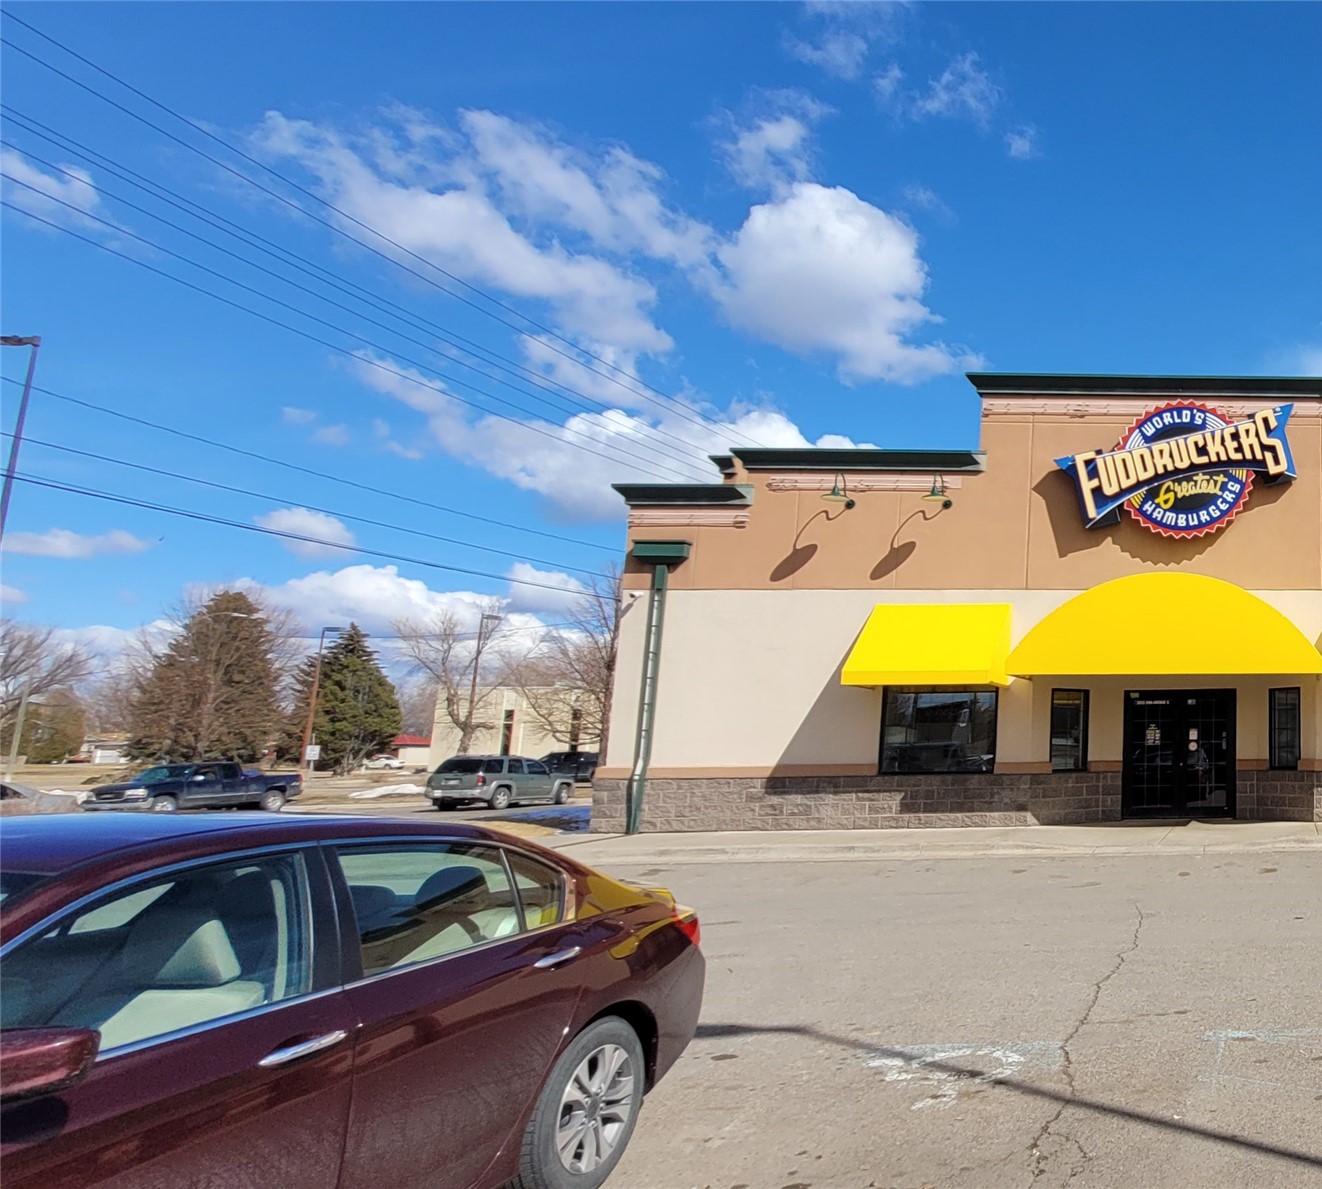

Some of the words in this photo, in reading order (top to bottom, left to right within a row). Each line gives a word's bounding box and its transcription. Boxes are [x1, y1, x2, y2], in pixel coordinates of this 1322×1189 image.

[1142, 410, 1204, 436] WORLD'S
[1074, 409, 1288, 519] FUDDRUCKERS
[1142, 482, 1241, 527] HAMBURGERS
[1155, 474, 1227, 509] Greatest
